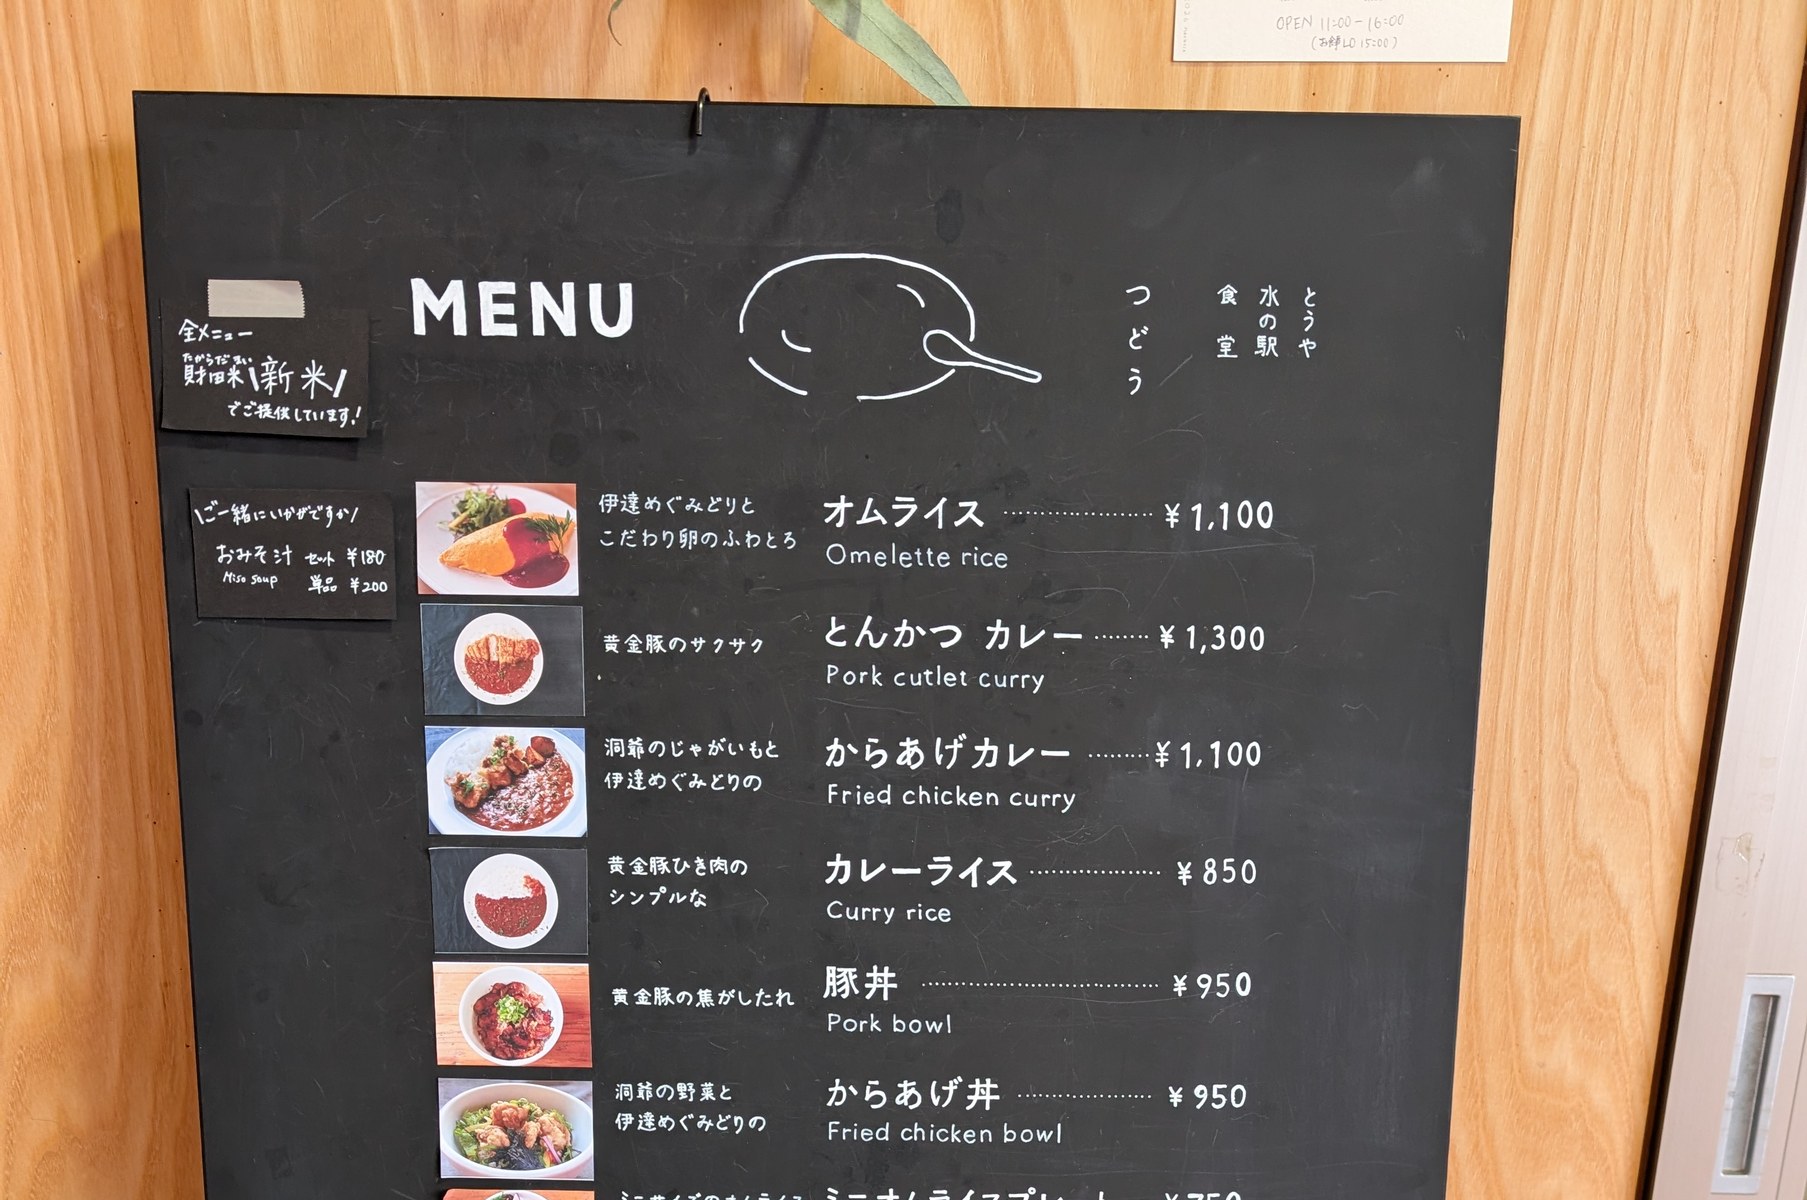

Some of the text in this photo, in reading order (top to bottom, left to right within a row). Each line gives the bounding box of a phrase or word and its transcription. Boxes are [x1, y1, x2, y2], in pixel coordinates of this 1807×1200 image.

[1276, 14, 1313, 31] OPEN
[410, 277, 633, 339] MENU
[178, 318, 253, 343] 全メニュー
[1253, 284, 1280, 358] 水の駅
[1298, 286, 1317, 359] とうや
[1125, 285, 1151, 396] つどう
[598, 491, 755, 515] 伊達めぐみどりと
[823, 494, 985, 530] オムライス
[599, 527, 797, 551] こだわり卵のふわとろ
[215, 543, 387, 568] おみそ汁 セット ¥180
[825, 542, 1008, 569] Omelette rice
[222, 570, 279, 590] Miso soup
[307, 573, 388, 595] 単品 ¥200
[603, 633, 763, 655] 黄金豚のサクサク
[824, 614, 963, 649] とんかつ
[985, 618, 1083, 651] カレー
[826, 664, 1045, 695] Pork cutlet curry
[604, 736, 779, 760] 洞爺のじゃがいもと
[825, 732, 1070, 771] からあげカレー
[603, 768, 763, 792] 伊達めぐみどりの
[827, 783, 1076, 814] Fried chicken curry
[607, 855, 748, 877] 黄金豚ひき肉の
[824, 852, 1018, 889] カレーライス
[609, 885, 707, 908] シンプルな
[826, 900, 952, 925] Curry rice
[822, 964, 898, 1002] 豚丼
[611, 986, 795, 1009] 黄金豚の焦がしたれ
[827, 1012, 952, 1034] Pork bowl
[614, 1080, 732, 1102] 洞爺の野菜と
[826, 1075, 1001, 1111] からあげ丼
[614, 1111, 767, 1135] 伊達めぐみどりの
[828, 1120, 1062, 1145] Fried chicken bowl
